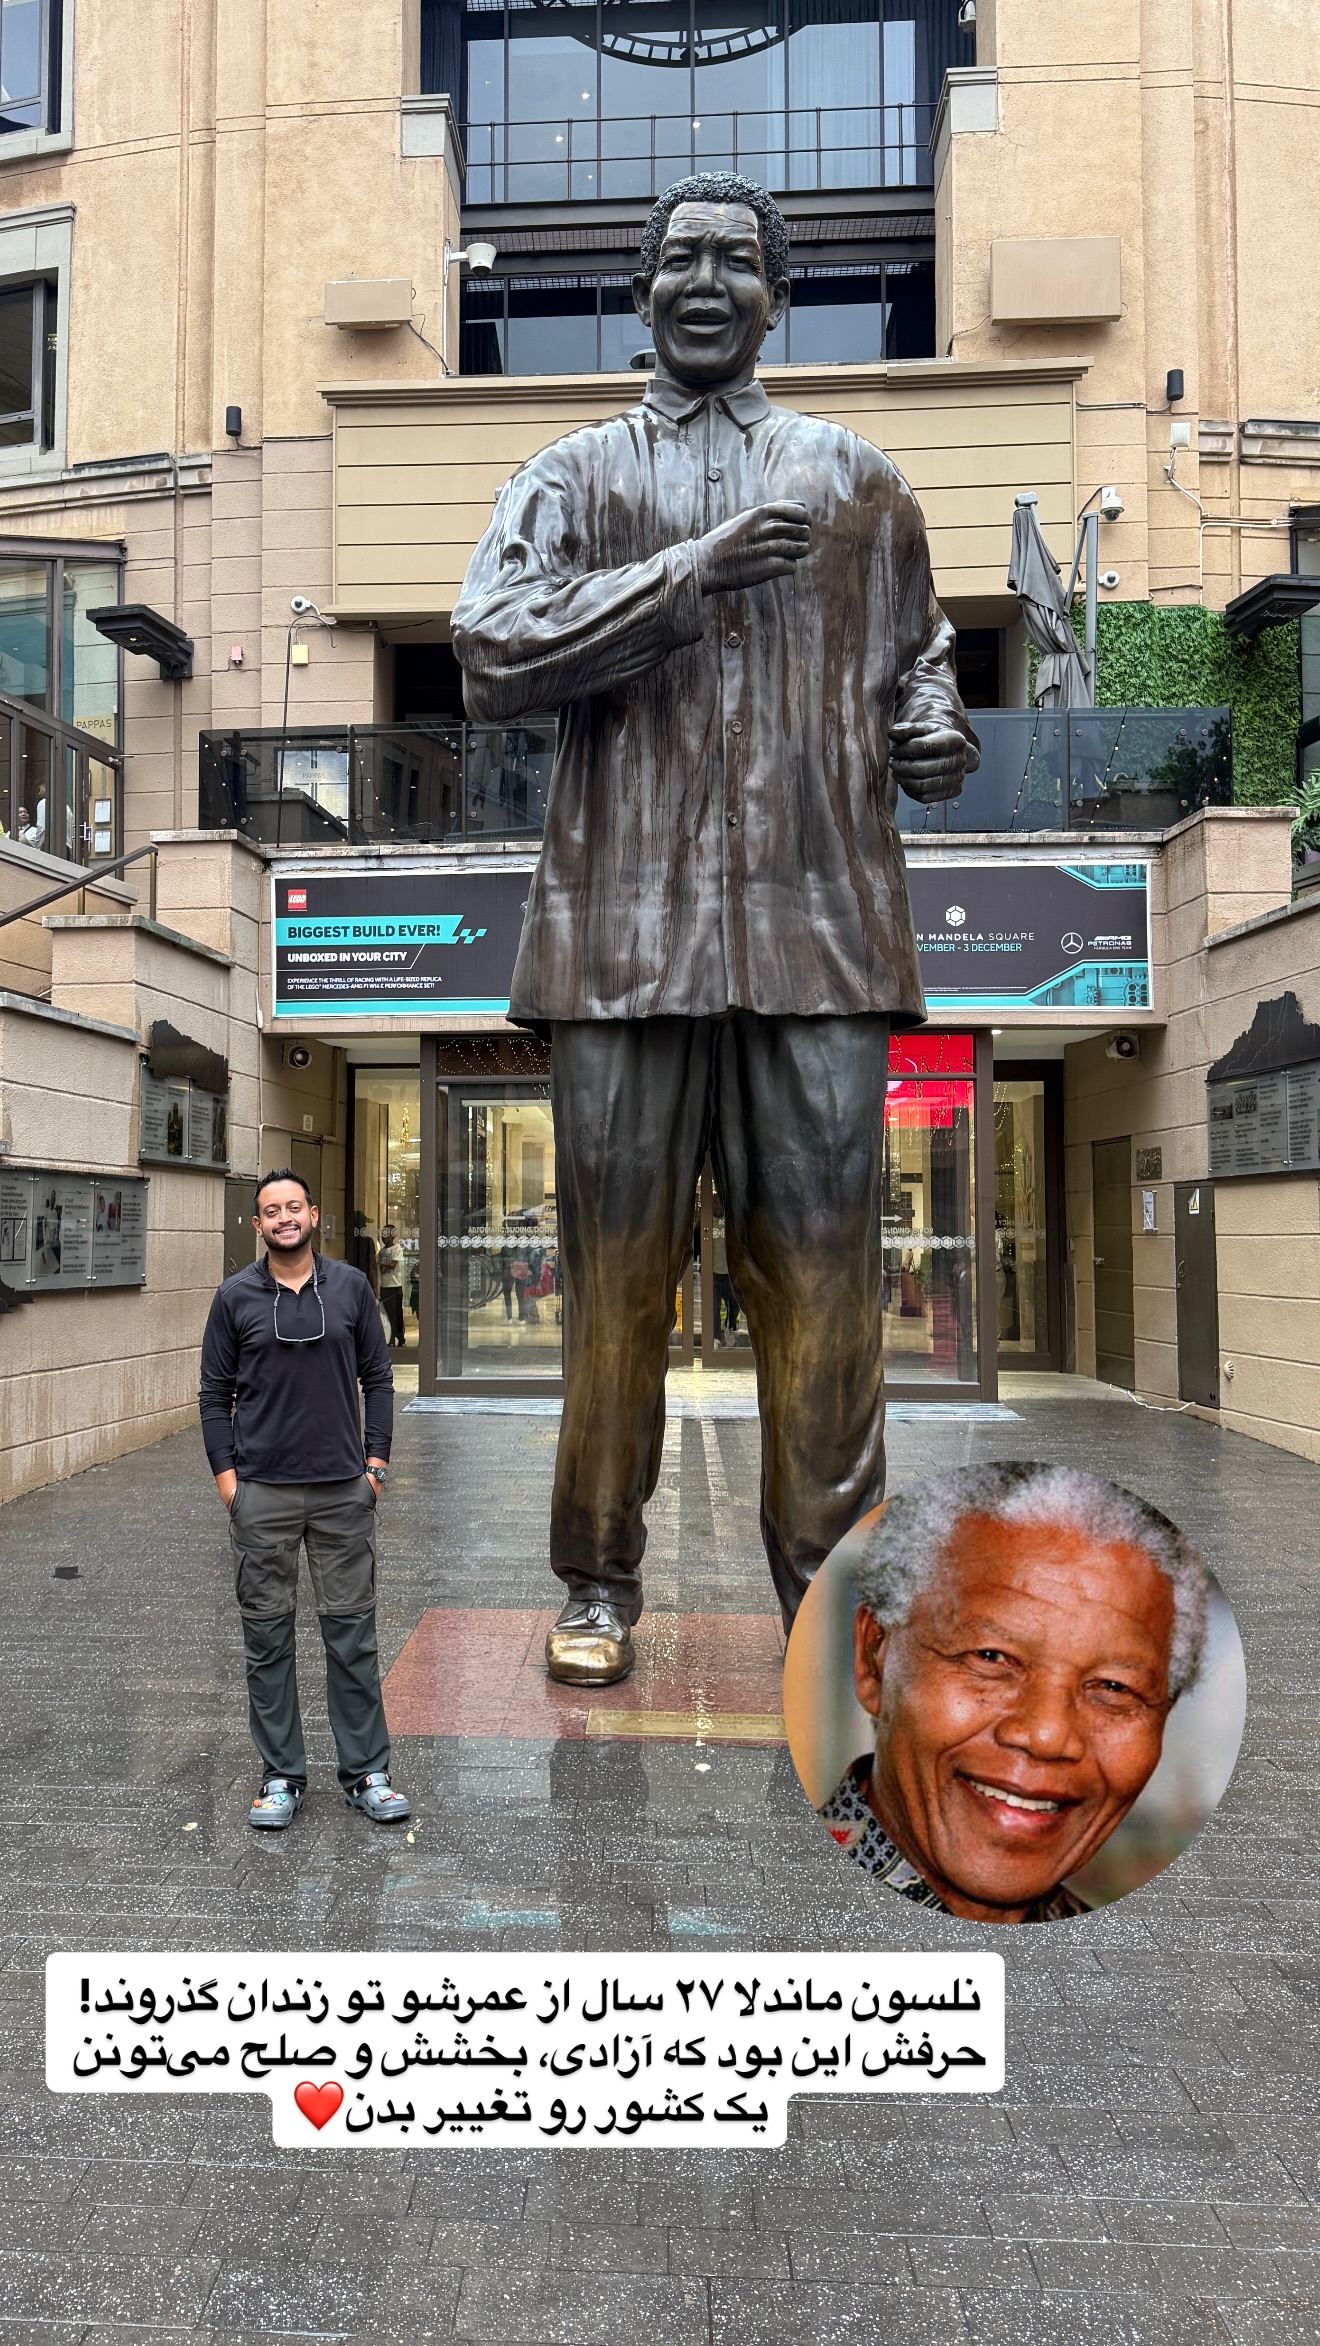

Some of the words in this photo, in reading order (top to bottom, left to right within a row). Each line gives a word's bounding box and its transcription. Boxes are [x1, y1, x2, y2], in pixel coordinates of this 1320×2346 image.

[76, 718, 112, 730] PAPPAS
[288, 895, 306, 904] LEGO
[288, 926, 350, 939] BIGGEST
[352, 925, 395, 938] BUILD
[398, 924, 441, 937] EVER!
[929, 933, 984, 942] MANDELA
[988, 932, 1035, 941] SQUARE
[916, 943, 956, 952] VEMBER
[963, 943, 969, 952] 3
[971, 943, 1022, 952] DECEMBER
[287, 952, 338, 963] UNBOXED
[339, 952, 350, 962] IN
[351, 952, 381, 962] YOUR
[382, 951, 407, 962] CITY
